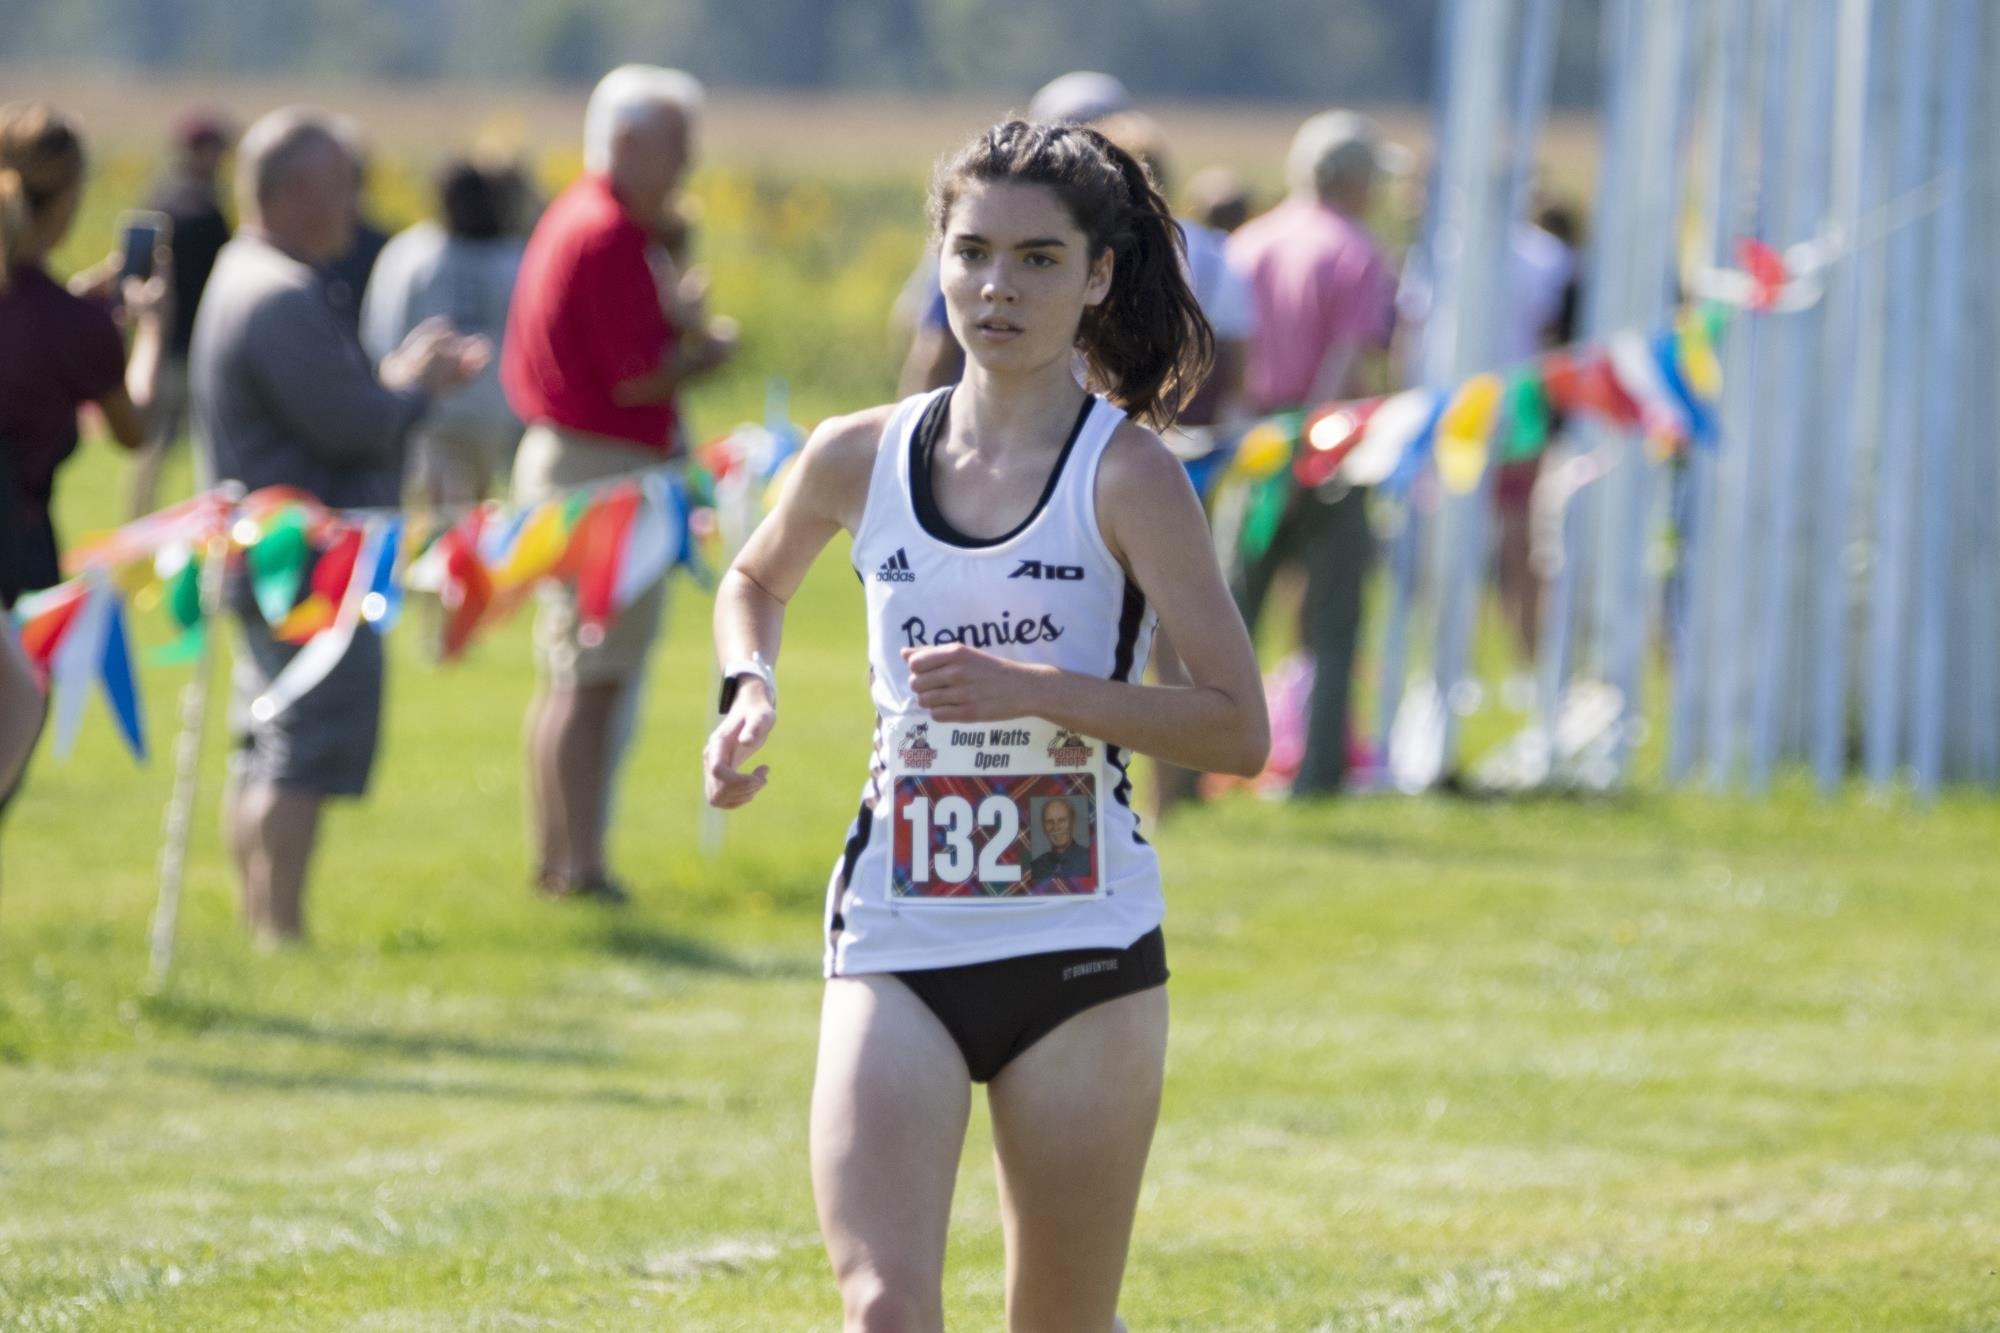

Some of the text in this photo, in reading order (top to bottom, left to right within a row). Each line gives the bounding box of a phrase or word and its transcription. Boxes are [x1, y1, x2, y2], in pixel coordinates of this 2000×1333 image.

[875, 569, 916, 582] adidas
[1008, 560, 1085, 580] A10
[951, 729, 1031, 747] Doug Watts
[974, 751, 1010, 770] Open
[903, 795, 1021, 883] 132
